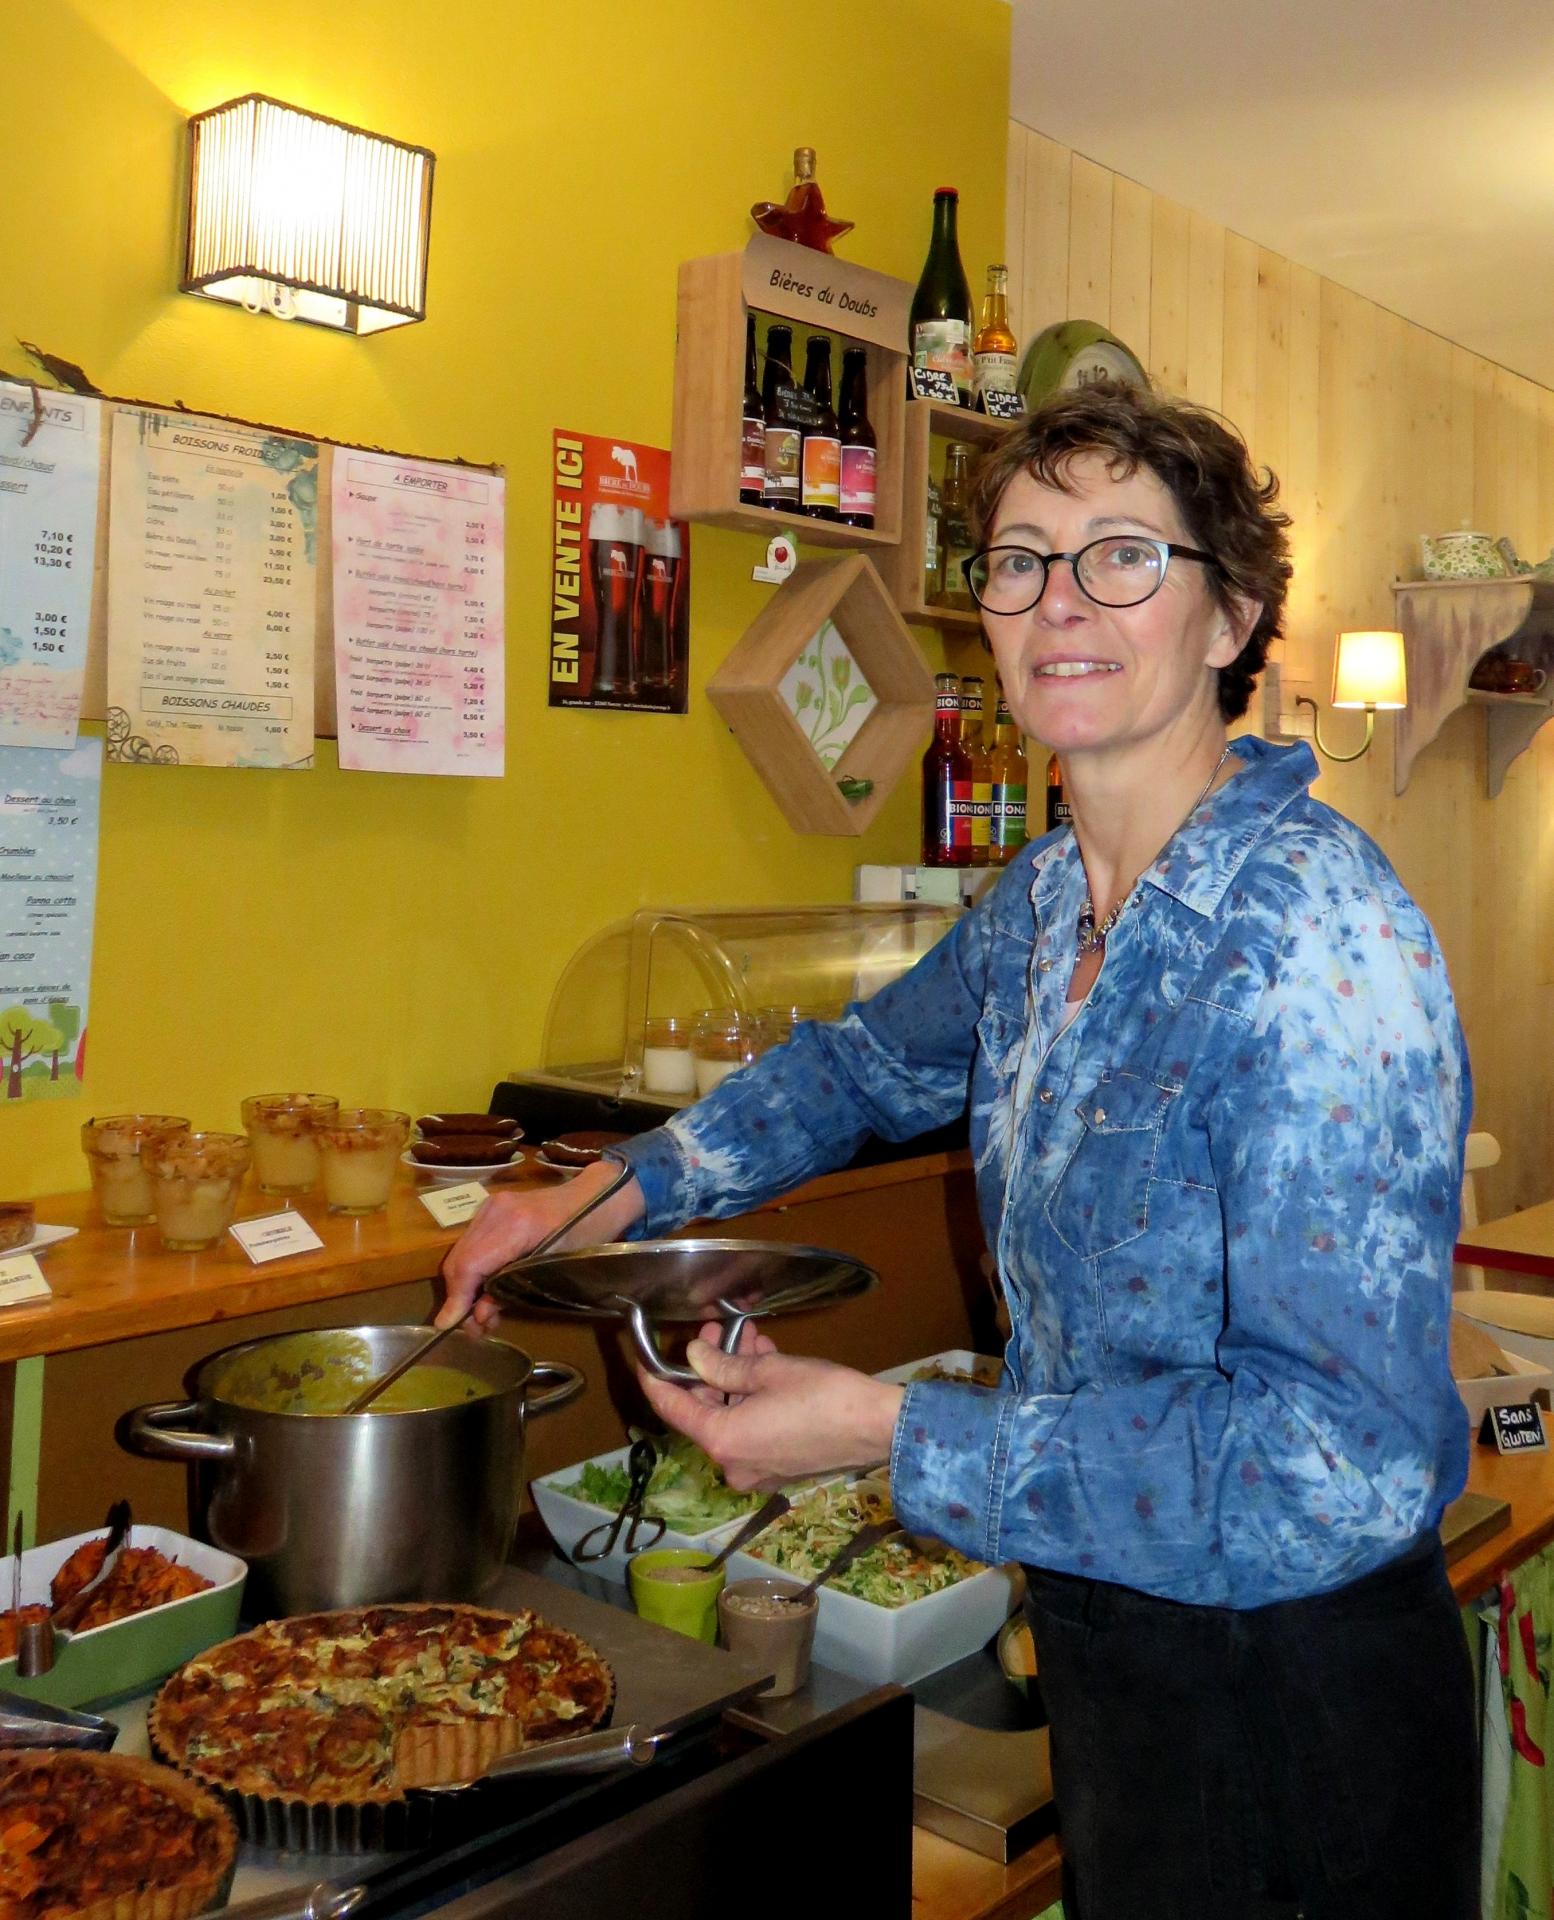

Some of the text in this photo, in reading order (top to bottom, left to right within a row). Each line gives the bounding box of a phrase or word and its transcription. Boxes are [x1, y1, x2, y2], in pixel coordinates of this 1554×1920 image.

[770, 269, 878, 318] Bières du Doubs
[172, 434, 280, 461] BOISSONS FROIDES
[403, 475, 448, 491] EMPORTER
[42, 530, 64, 540] 7,10
[34, 544, 72, 556] 10,20 €
[552, 438, 584, 683] EN VENTE ICI
[35, 612, 67, 624] 3,00 €
[34, 626, 66, 638] 1,50 €
[32, 642, 65, 652] 1,50 €
[162, 696, 271, 712] BOISSONS CHAUDES
[70, 817, 79, 825] €
[1499, 1408, 1533, 1425] Sans
[1500, 1428, 1540, 1447] GLUTEN
